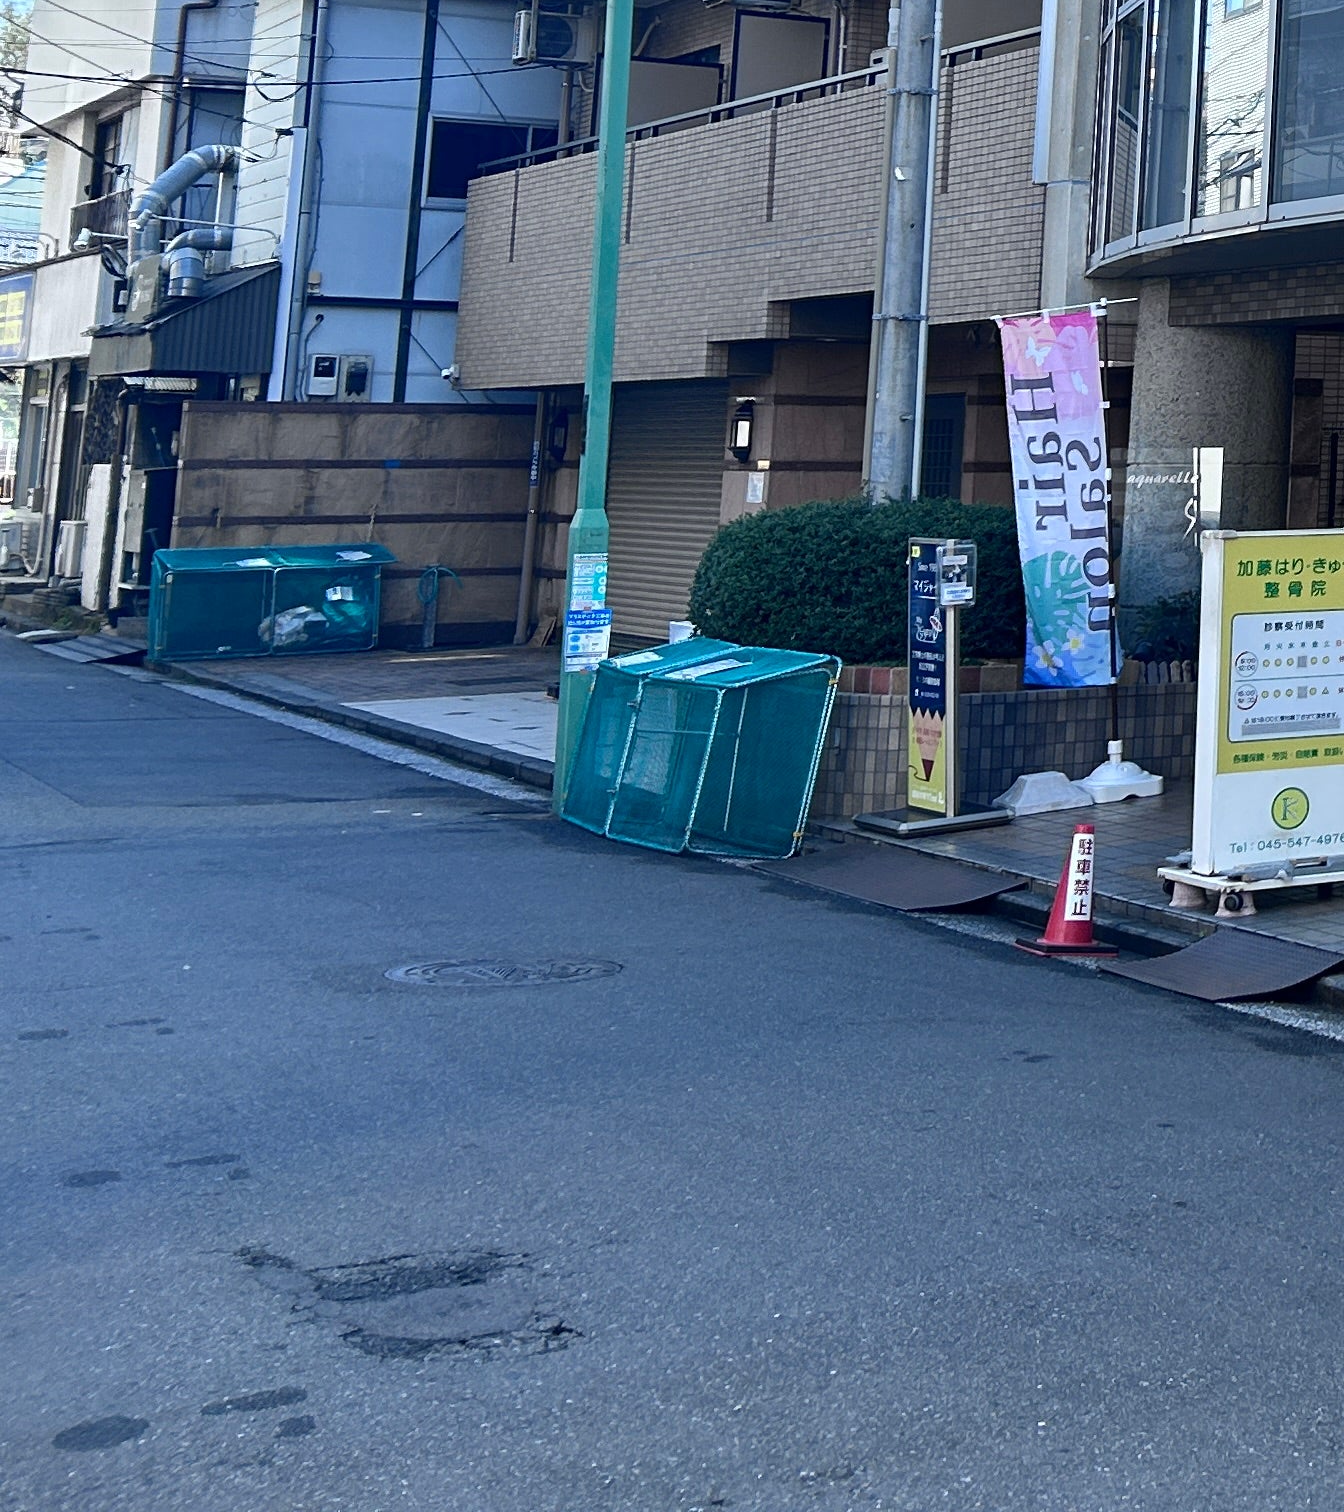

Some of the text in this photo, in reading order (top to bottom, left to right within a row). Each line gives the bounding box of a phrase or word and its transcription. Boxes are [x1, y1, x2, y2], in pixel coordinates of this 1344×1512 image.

[1263, 579, 1327, 599] 整骨院
[1071, 838, 1093, 916] 駐車禁止
